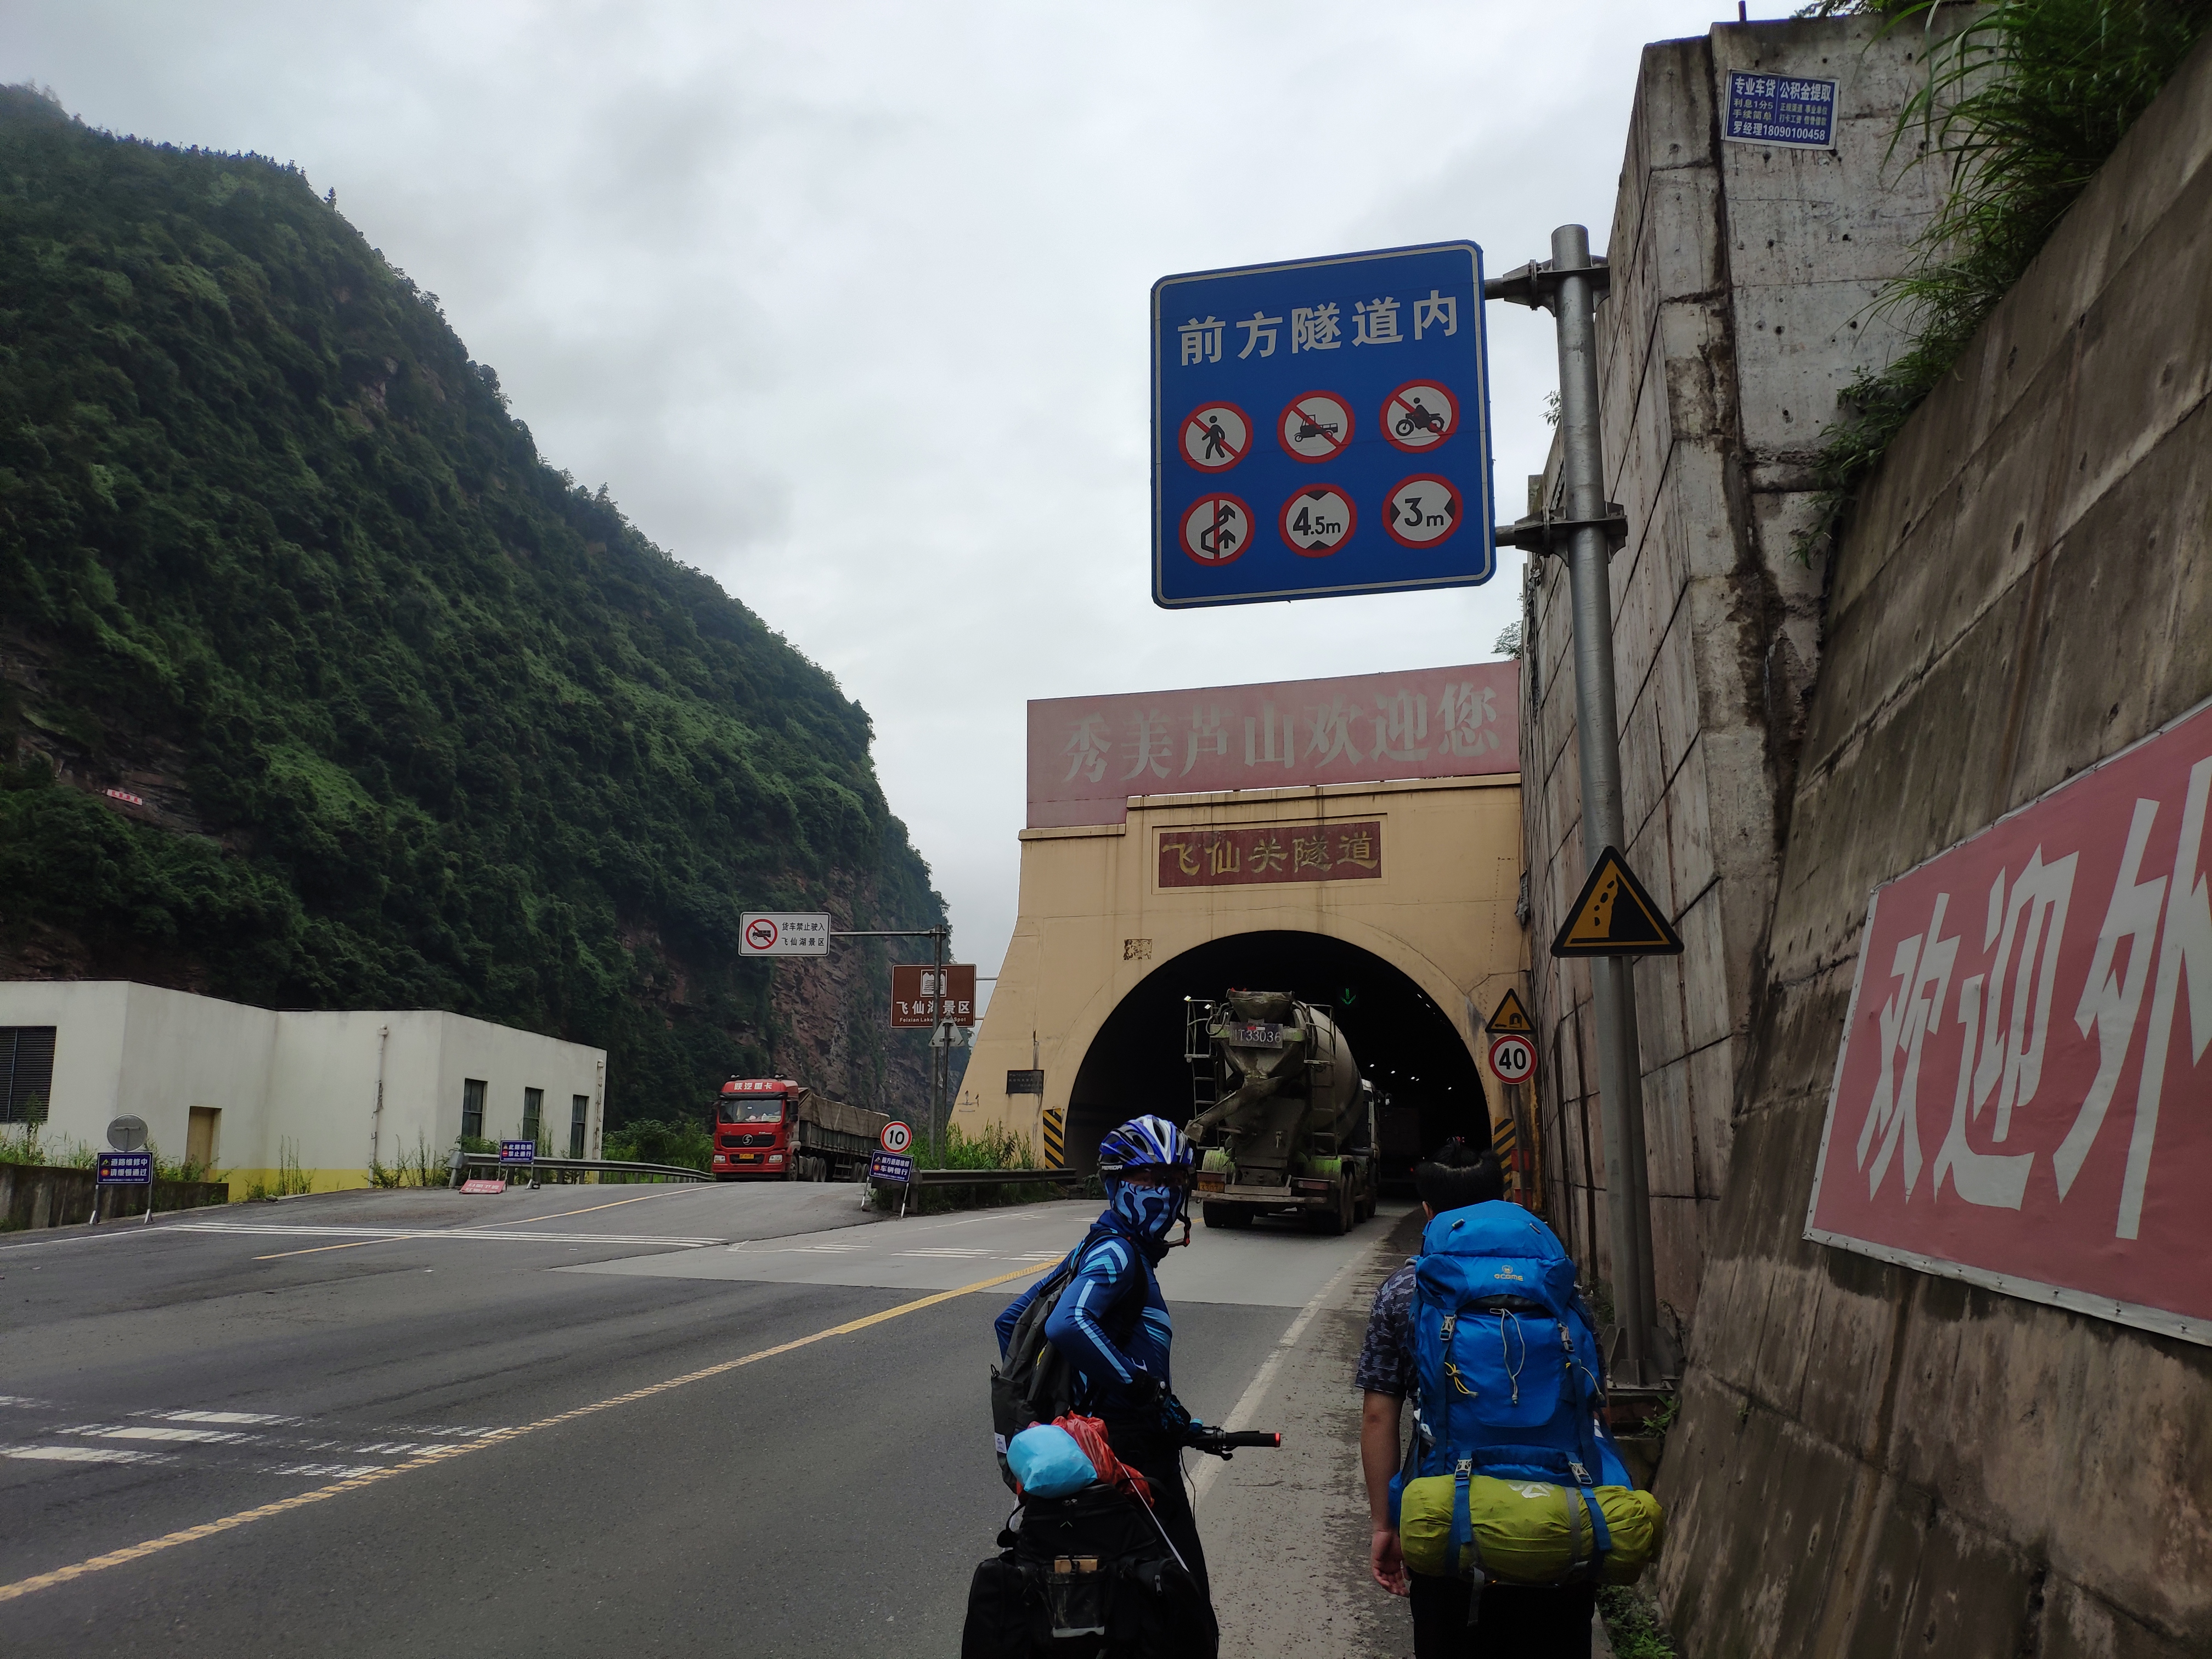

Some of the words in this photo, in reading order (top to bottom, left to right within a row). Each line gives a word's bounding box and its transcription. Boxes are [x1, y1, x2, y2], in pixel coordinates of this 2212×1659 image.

[1735, 76, 1776, 98] 专业车贷
[1779, 81, 1832, 103] 公积金提取
[1734, 98, 1773, 109] 利息1分5
[1733, 120, 1826, 141] 罗经理18090100458
[1177, 290, 1458, 366] 前方隧道内
[1293, 506, 1341, 536] 4.5m
[1404, 498, 1444, 527] 3m
[1061, 681, 1502, 784] 秀美芦山欢迎您
[1162, 831, 1379, 877] 飞仙关隧道
[782, 922, 825, 932] 货车禁止驶入
[781, 937, 825, 946] 飞仙湖景区
[1499, 1048, 1526, 1070] 40
[889, 1130, 905, 1145] 10
[110, 1158, 148, 1166] 道路维修中
